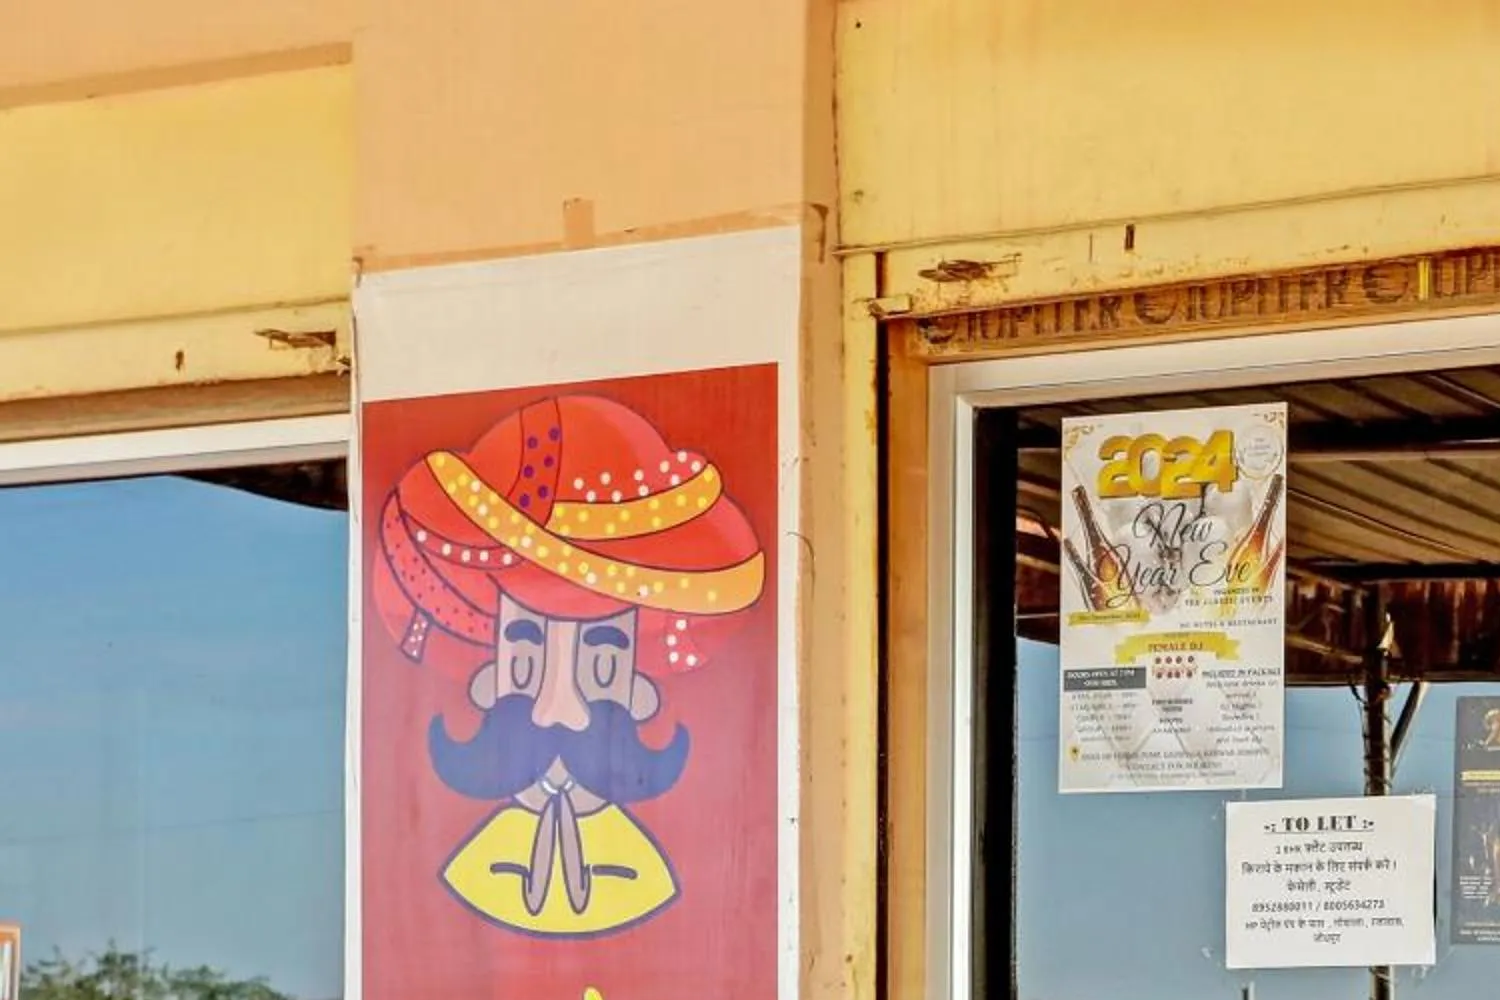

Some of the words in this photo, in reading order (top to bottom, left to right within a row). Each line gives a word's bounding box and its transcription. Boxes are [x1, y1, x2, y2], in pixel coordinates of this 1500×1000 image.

[1096, 429, 1239, 500] 2024
[1132, 502, 1213, 548] New
[1106, 544, 1178, 608] Year
[1189, 542, 1250, 586] Eve
[1281, 816, 1310, 832] TO
[1316, 815, 1357, 831] LET
